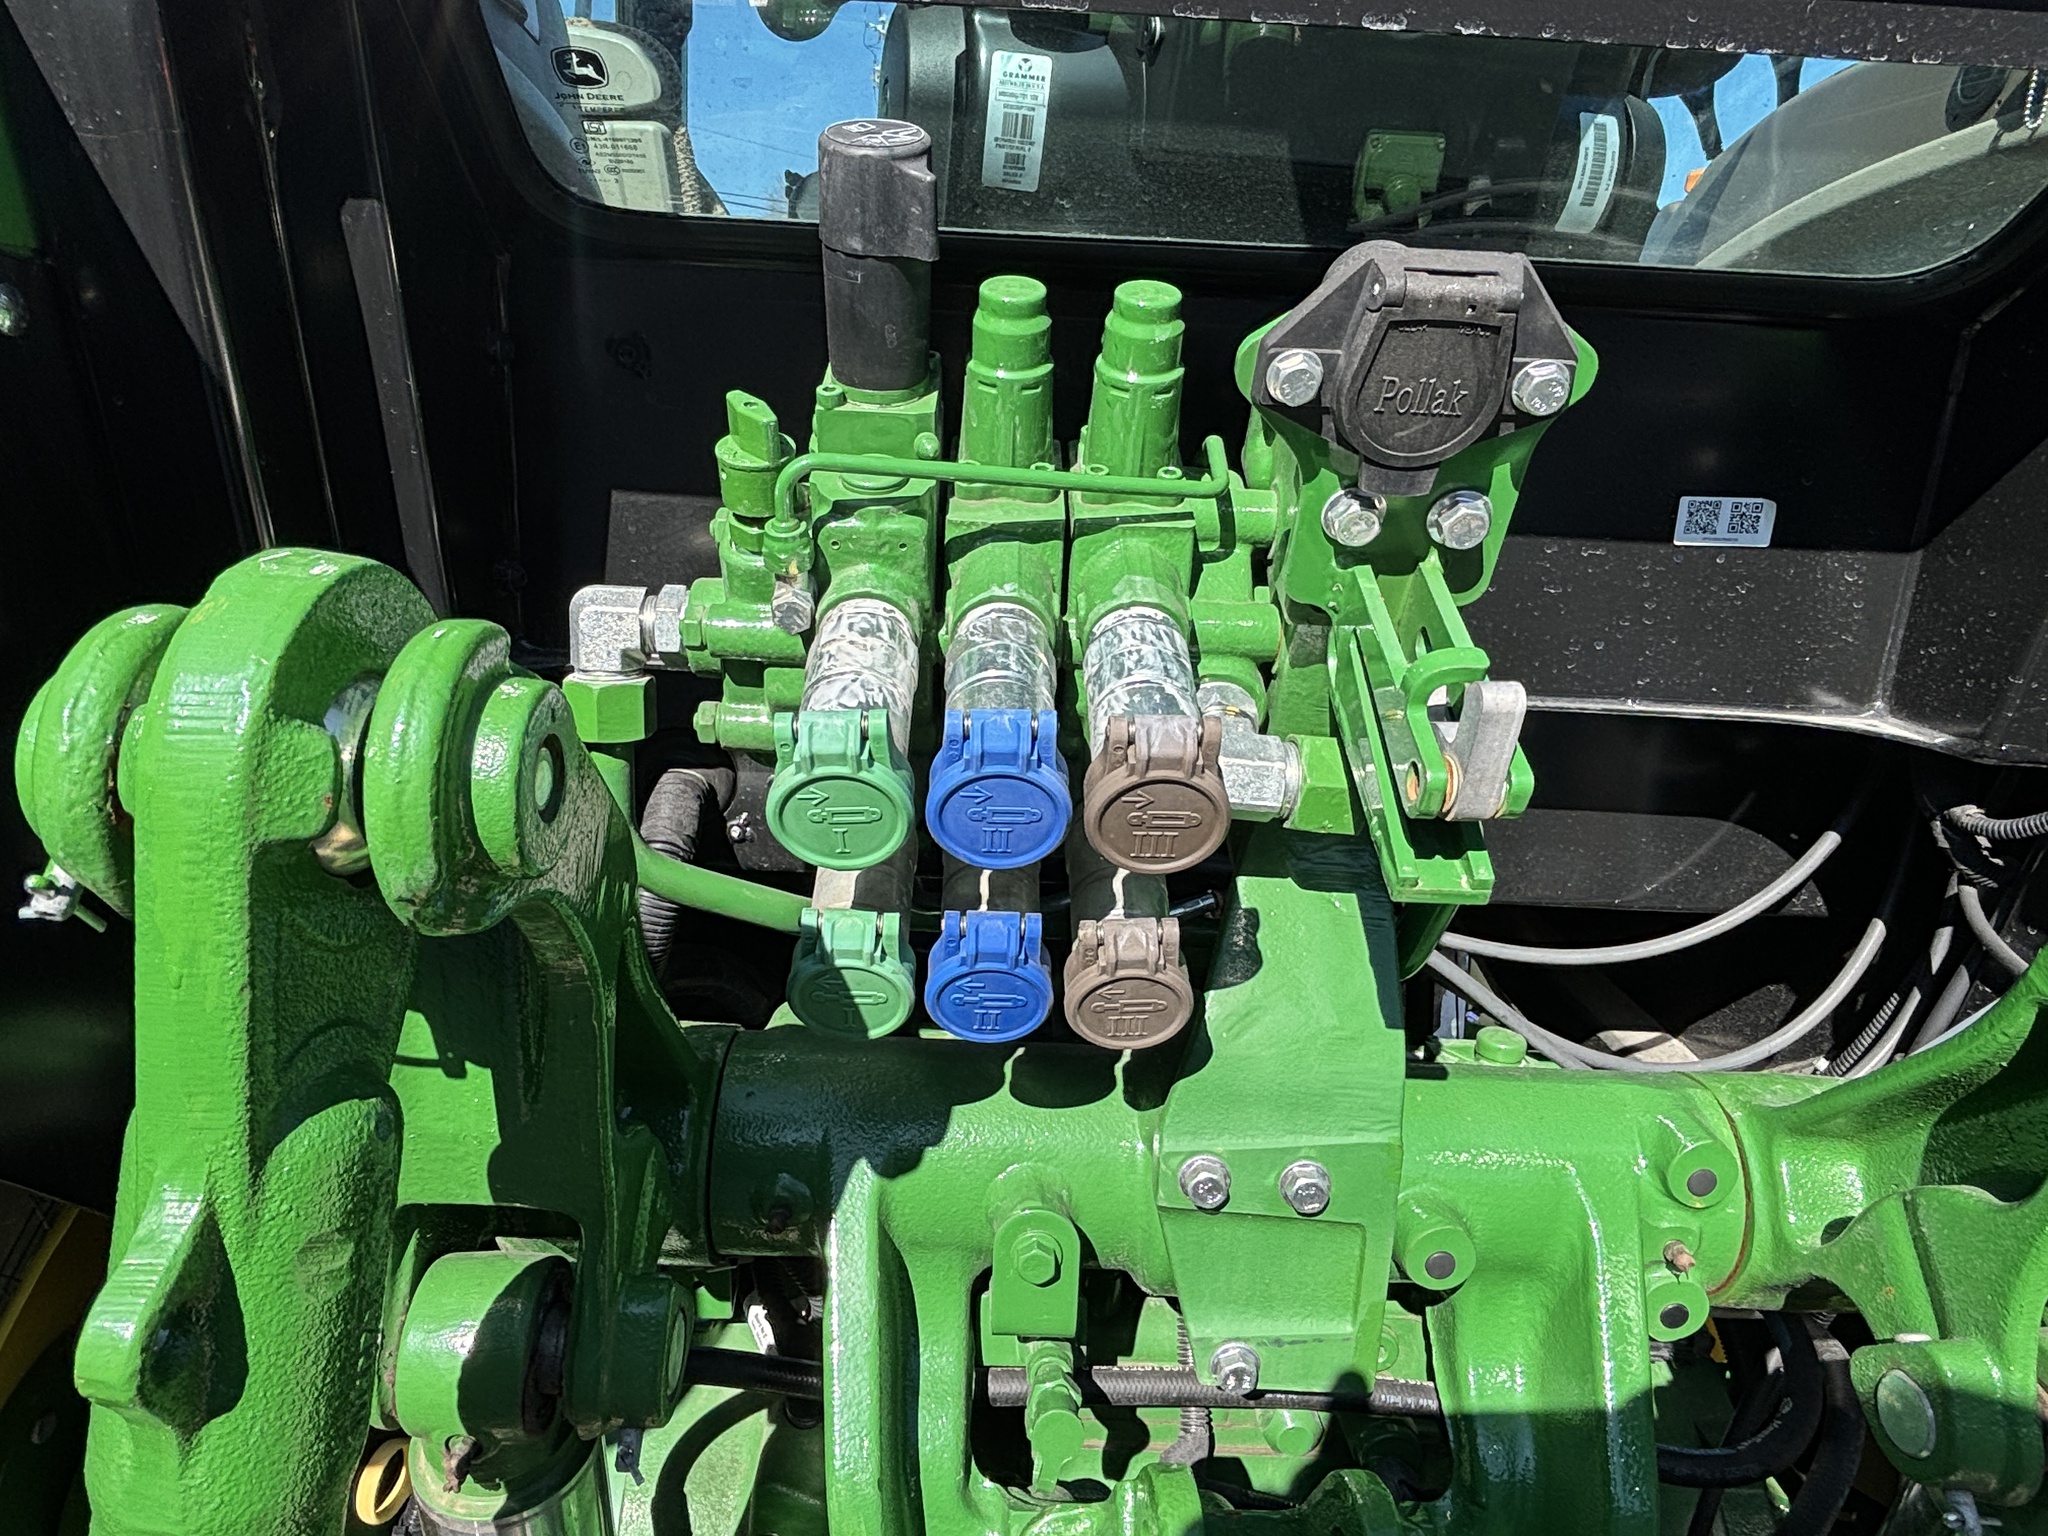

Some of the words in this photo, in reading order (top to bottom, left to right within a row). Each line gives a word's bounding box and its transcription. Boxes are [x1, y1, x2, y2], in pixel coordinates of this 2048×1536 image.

[1002, 71, 1046, 82] GRAMMER
[555, 92, 584, 101] JOHN
[586, 92, 625, 102] DEERE
[1373, 375, 1469, 417] Pollak
[981, 827, 1013, 854] II
[1130, 831, 1178, 859] III
[972, 1009, 1002, 1031] II
[1106, 1015, 1149, 1038] III
